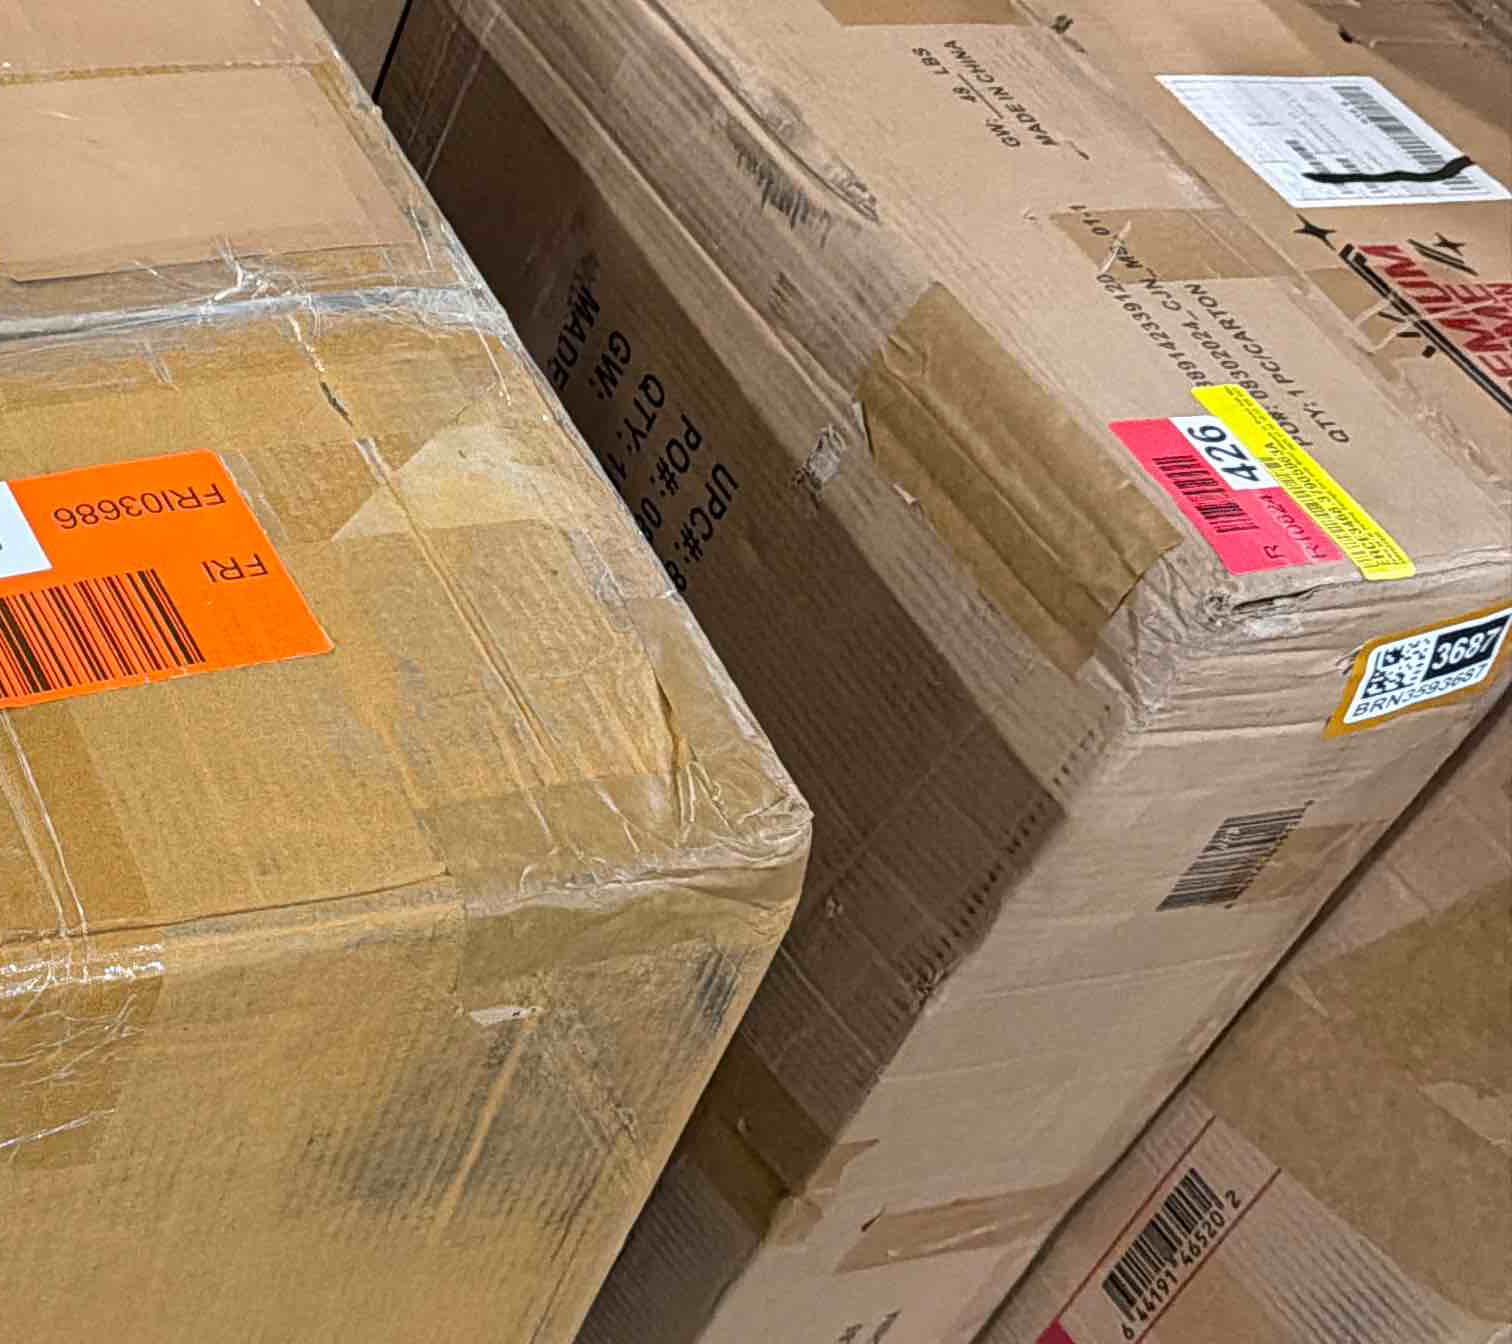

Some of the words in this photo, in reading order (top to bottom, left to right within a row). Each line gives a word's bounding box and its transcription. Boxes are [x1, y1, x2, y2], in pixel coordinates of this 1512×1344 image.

[911, 46, 950, 77] LBS
[943, 39, 996, 84] CHINA
[988, 84, 1014, 102] IN
[1004, 103, 1061, 147] MADE
[552, 288, 600, 392] MADE
[1184, 282, 1295, 386] PC/CARTON
[589, 329, 632, 401] GW:
[618, 373, 666, 455] QTY:
[1304, 398, 1350, 445] QTY:
[649, 413, 704, 498] PO#:
[1186, 423, 1264, 484] 426
[52, 482, 228, 531] FRI03686
[673, 462, 740, 564] UPC#:
[200, 552, 268, 585] FRI
[1263, 543, 1289, 561] R
[1431, 626, 1504, 670] 3687
[1351, 661, 1489, 718] BRN3593687
[1120, 1322, 1135, 1342] 6
[1134, 1269, 1182, 1325] 44191
[1178, 1210, 1226, 1269] 46520
[1224, 1189, 1243, 1211] 2
